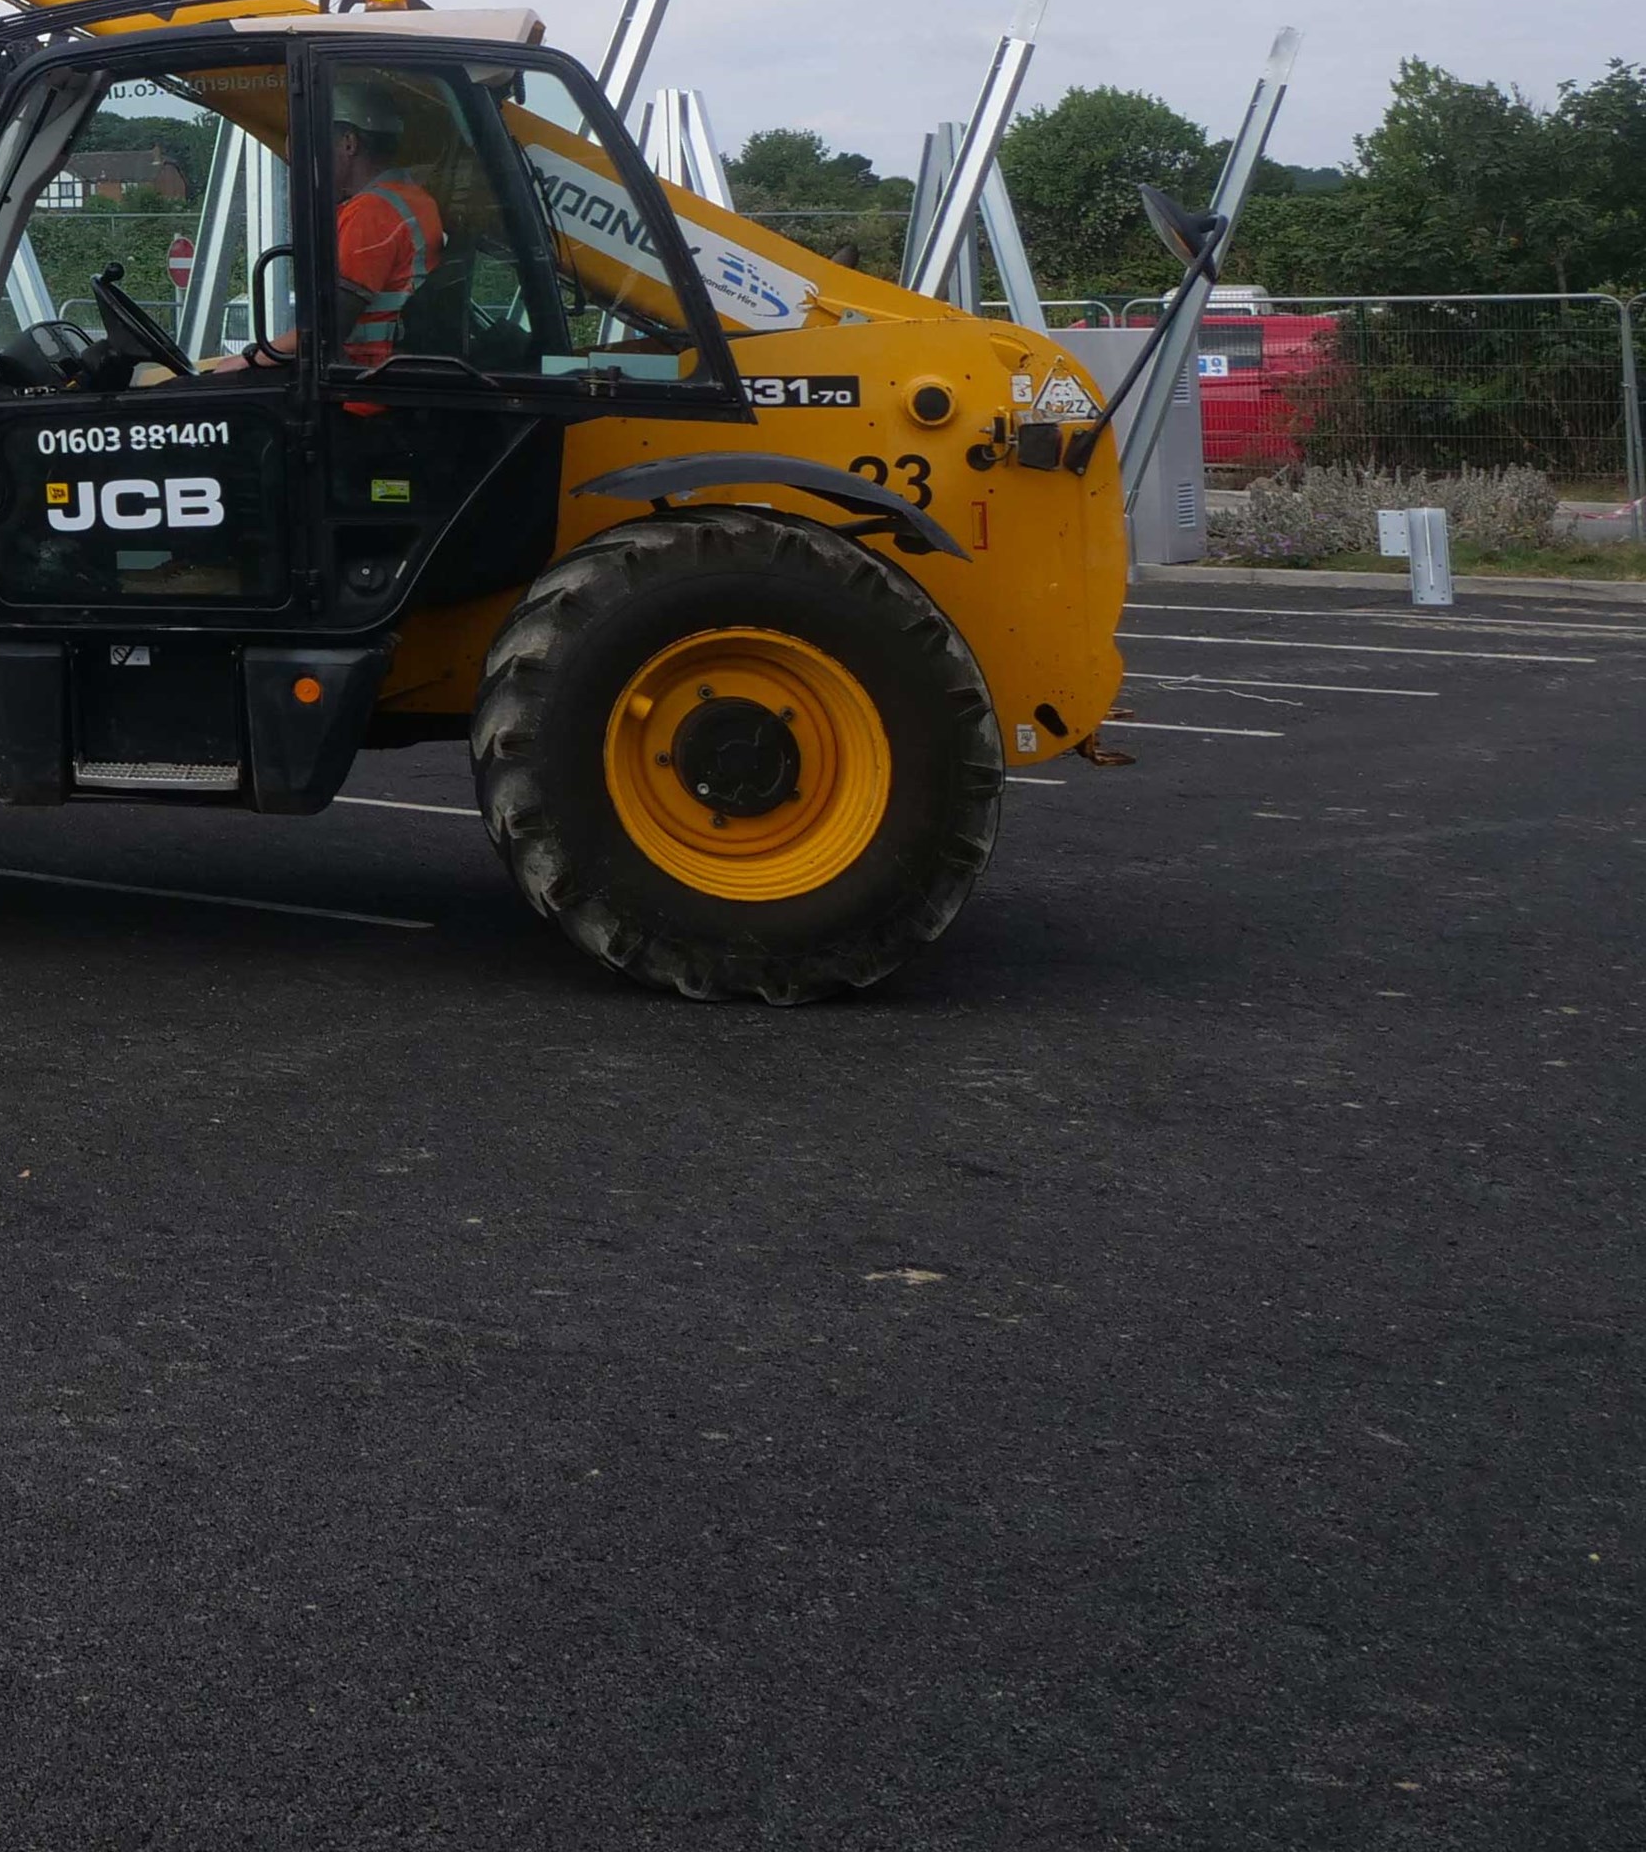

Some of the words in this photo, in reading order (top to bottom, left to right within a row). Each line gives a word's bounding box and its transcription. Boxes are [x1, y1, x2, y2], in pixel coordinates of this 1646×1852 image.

[737, 293, 758, 308] Hire
[38, 427, 121, 454] 01603
[129, 422, 229, 450] 881401
[47, 478, 224, 531] JCB
